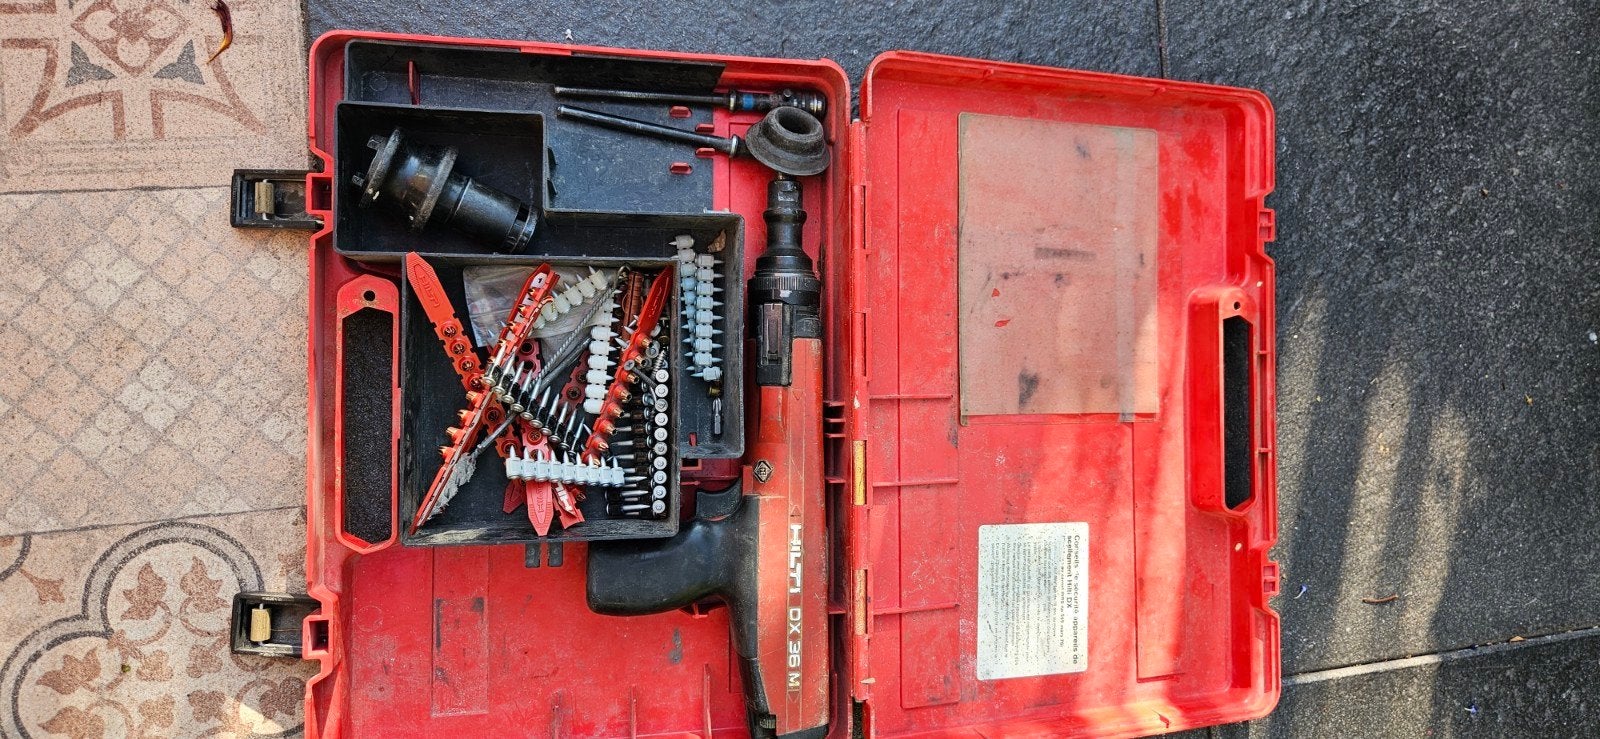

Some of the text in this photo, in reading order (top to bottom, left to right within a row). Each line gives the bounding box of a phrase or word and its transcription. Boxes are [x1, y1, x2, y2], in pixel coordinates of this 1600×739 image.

[788, 524, 802, 688] HILTI DX 36 M
[1066, 596, 1072, 609] DX
[1072, 654, 1079, 665] de
